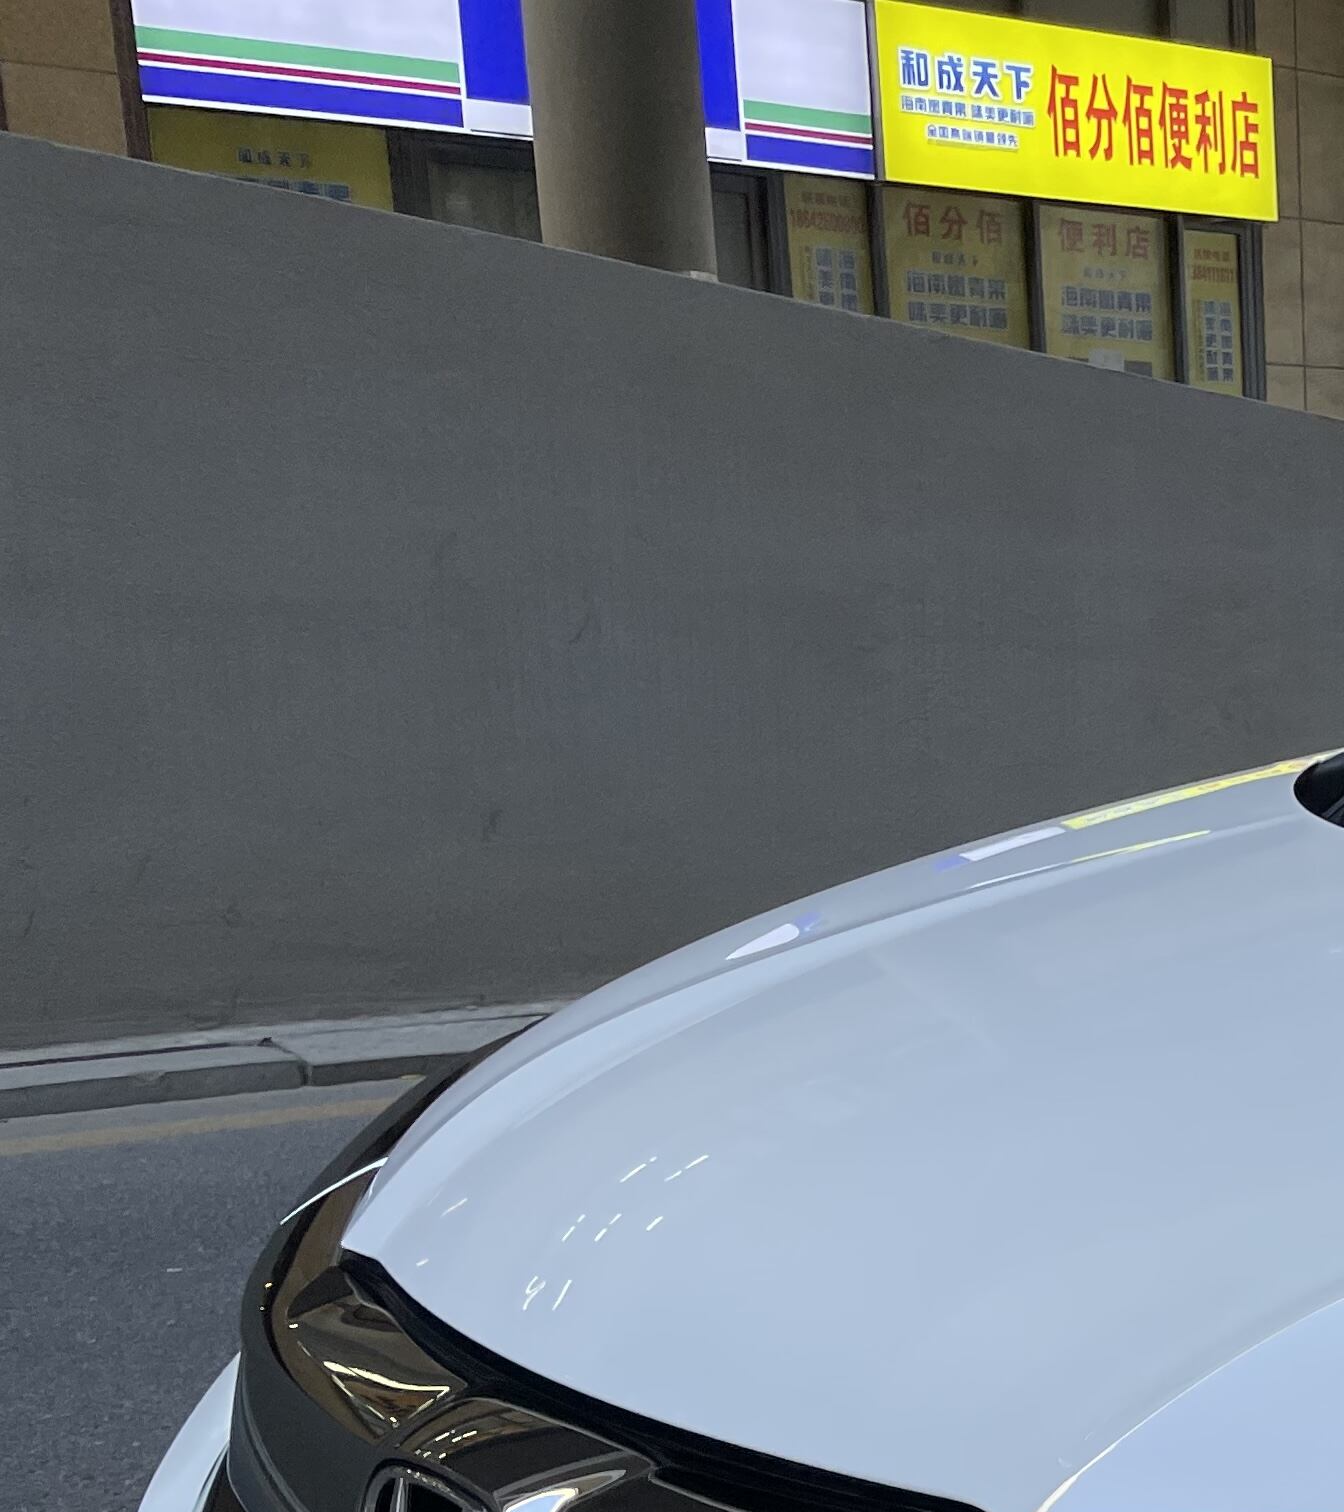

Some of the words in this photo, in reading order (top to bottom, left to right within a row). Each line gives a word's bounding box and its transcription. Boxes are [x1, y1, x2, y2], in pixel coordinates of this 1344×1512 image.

[899, 48, 1032, 101] 和成天下
[1047, 64, 1260, 179] 佰分佰便利店
